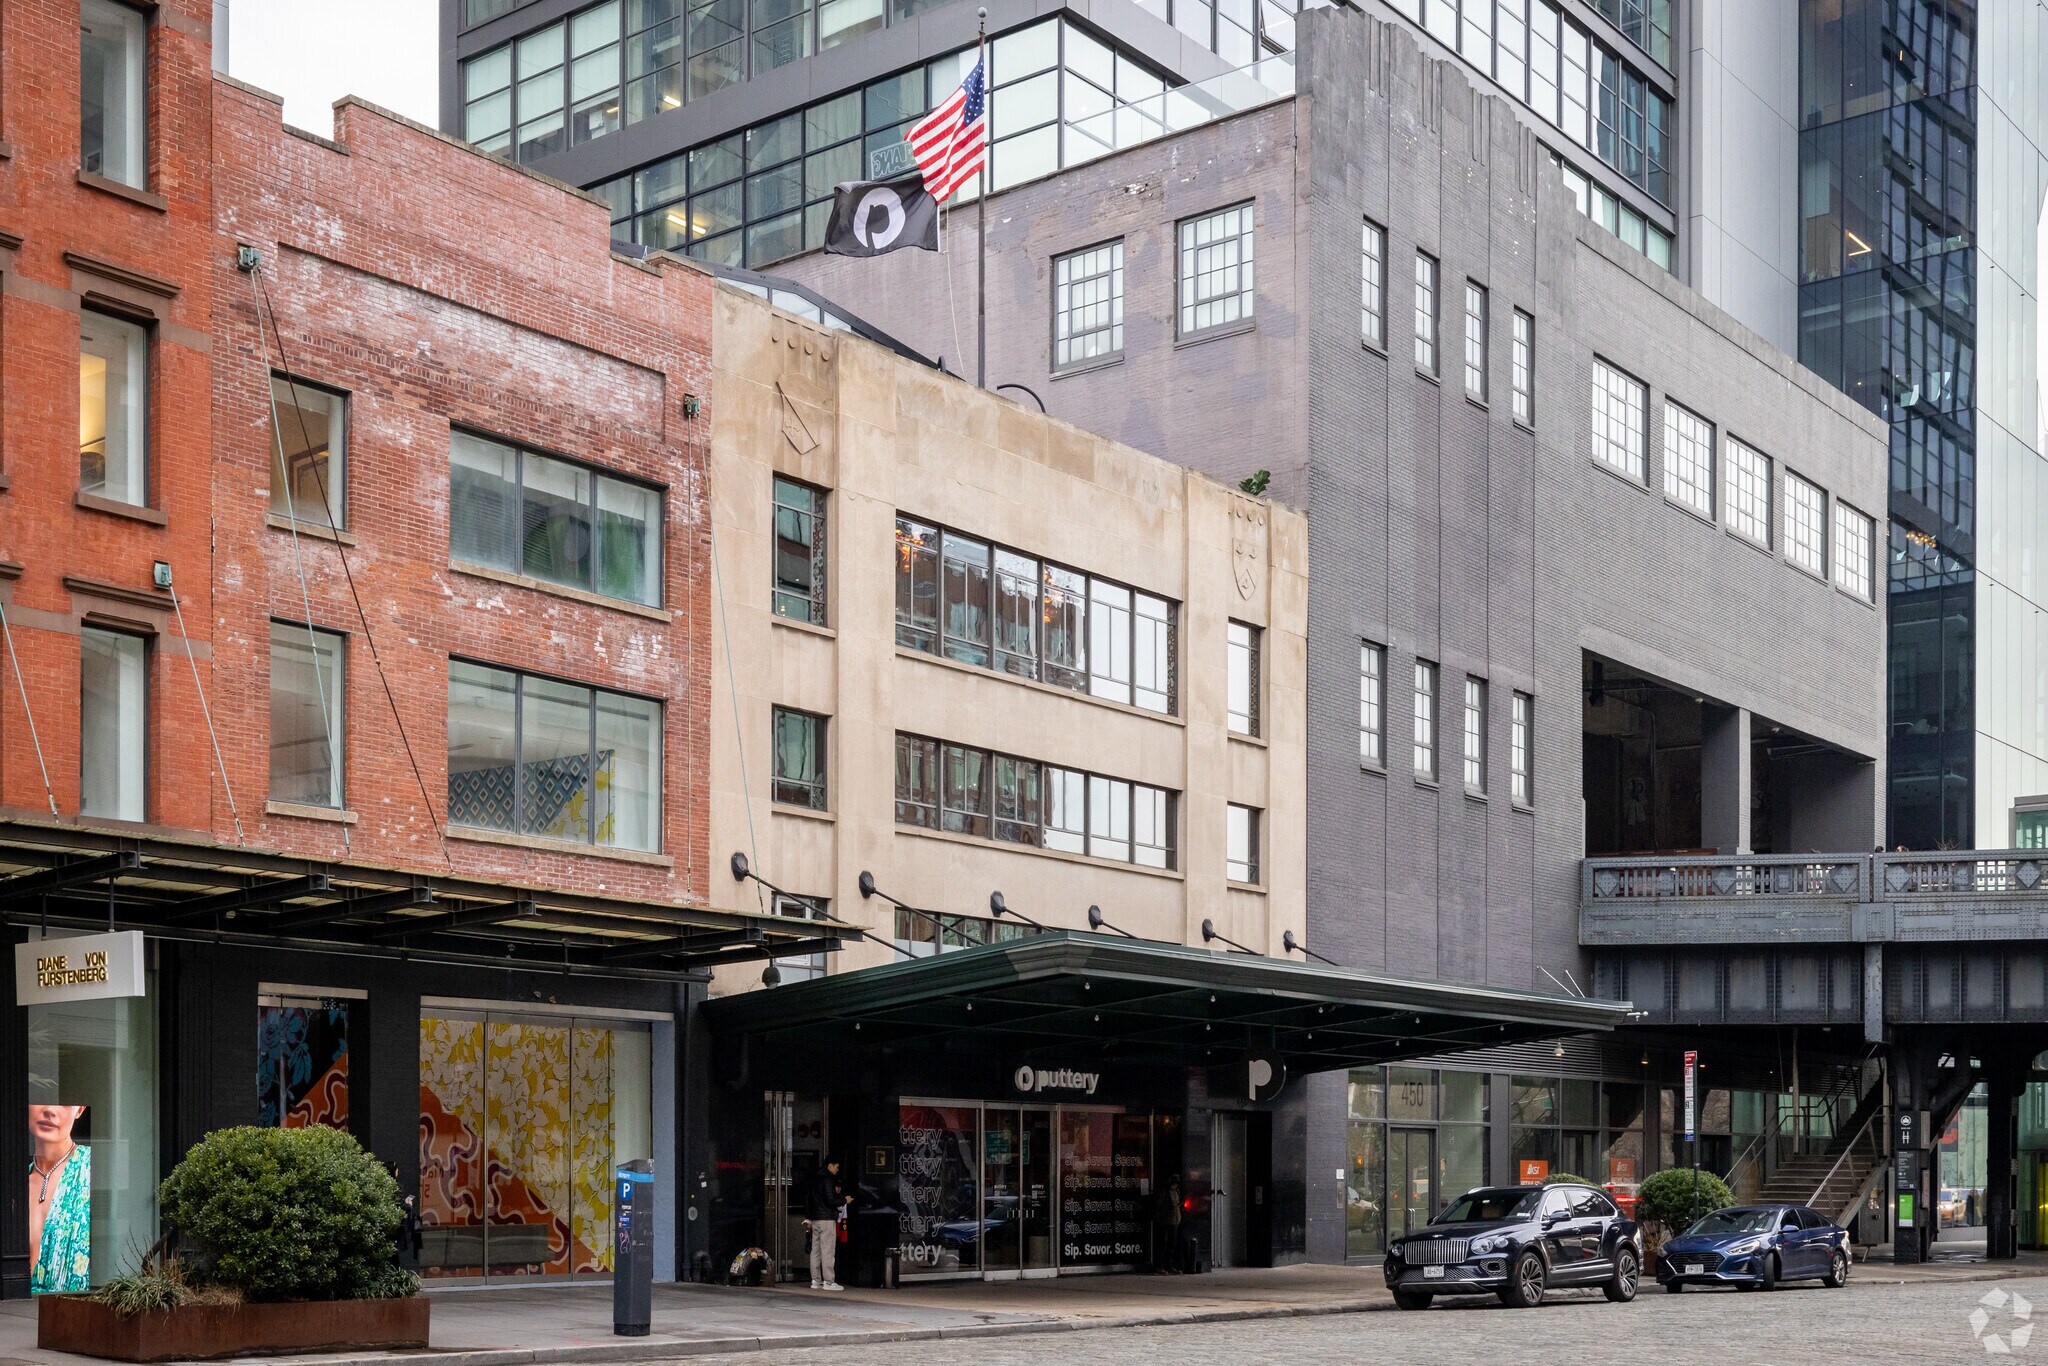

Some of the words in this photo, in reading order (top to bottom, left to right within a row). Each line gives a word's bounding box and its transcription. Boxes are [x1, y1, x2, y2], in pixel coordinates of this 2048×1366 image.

[37, 956, 67, 971] DIANE
[85, 951, 107, 966] VON
[38, 967, 107, 986] FURSTENBERG
[1035, 1068, 1099, 1094] puttery
[1402, 1082, 1423, 1107] 450
[1084, 1154, 1112, 1166] Savor.
[1115, 1154, 1143, 1166] Score.
[623, 1183, 631, 1198] P
[1065, 1174, 1082, 1192] Sip.
[1084, 1175, 1112, 1188] Savor.
[1065, 1198, 1082, 1215] Sip.
[1084, 1199, 1112, 1211] Savor.
[1065, 1220, 1082, 1238] Sip.
[1084, 1221, 1112, 1234] Savor.
[1065, 1243, 1081, 1259] Sip.
[1085, 1244, 1112, 1256] Savor.
[1115, 1243, 1143, 1254] Score.
